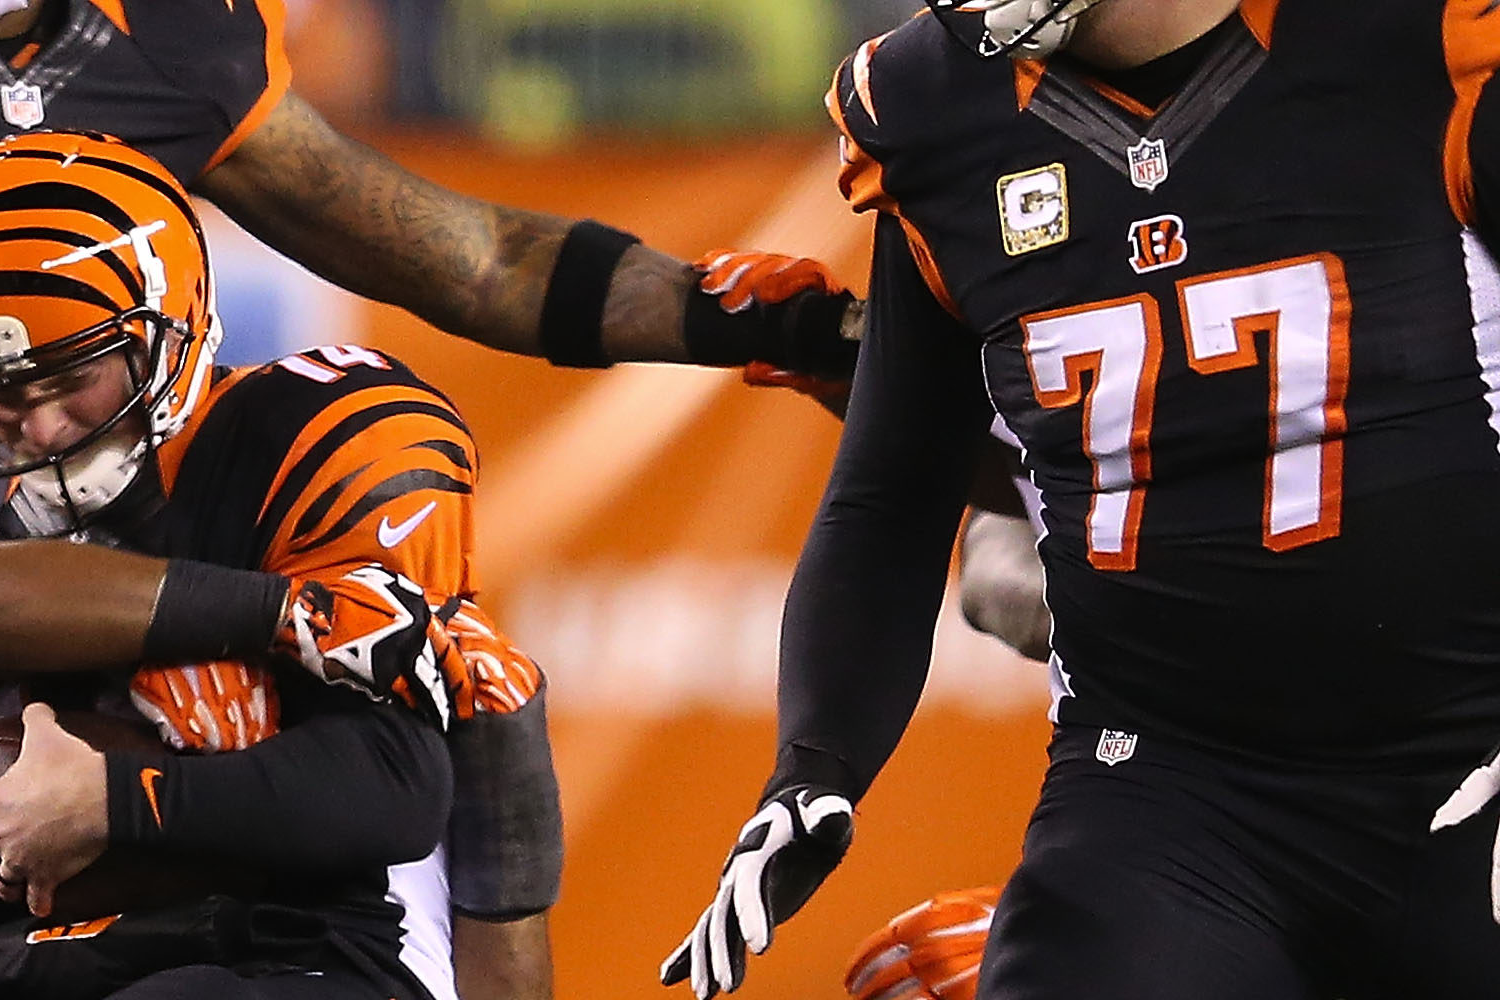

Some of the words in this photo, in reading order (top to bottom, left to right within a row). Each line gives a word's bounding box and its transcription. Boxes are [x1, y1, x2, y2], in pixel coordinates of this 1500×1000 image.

[1133, 160, 1165, 180] NFL
[1004, 171, 1060, 231] C
[1019, 250, 1352, 572] 77
[1102, 740, 1131, 757] NFL
